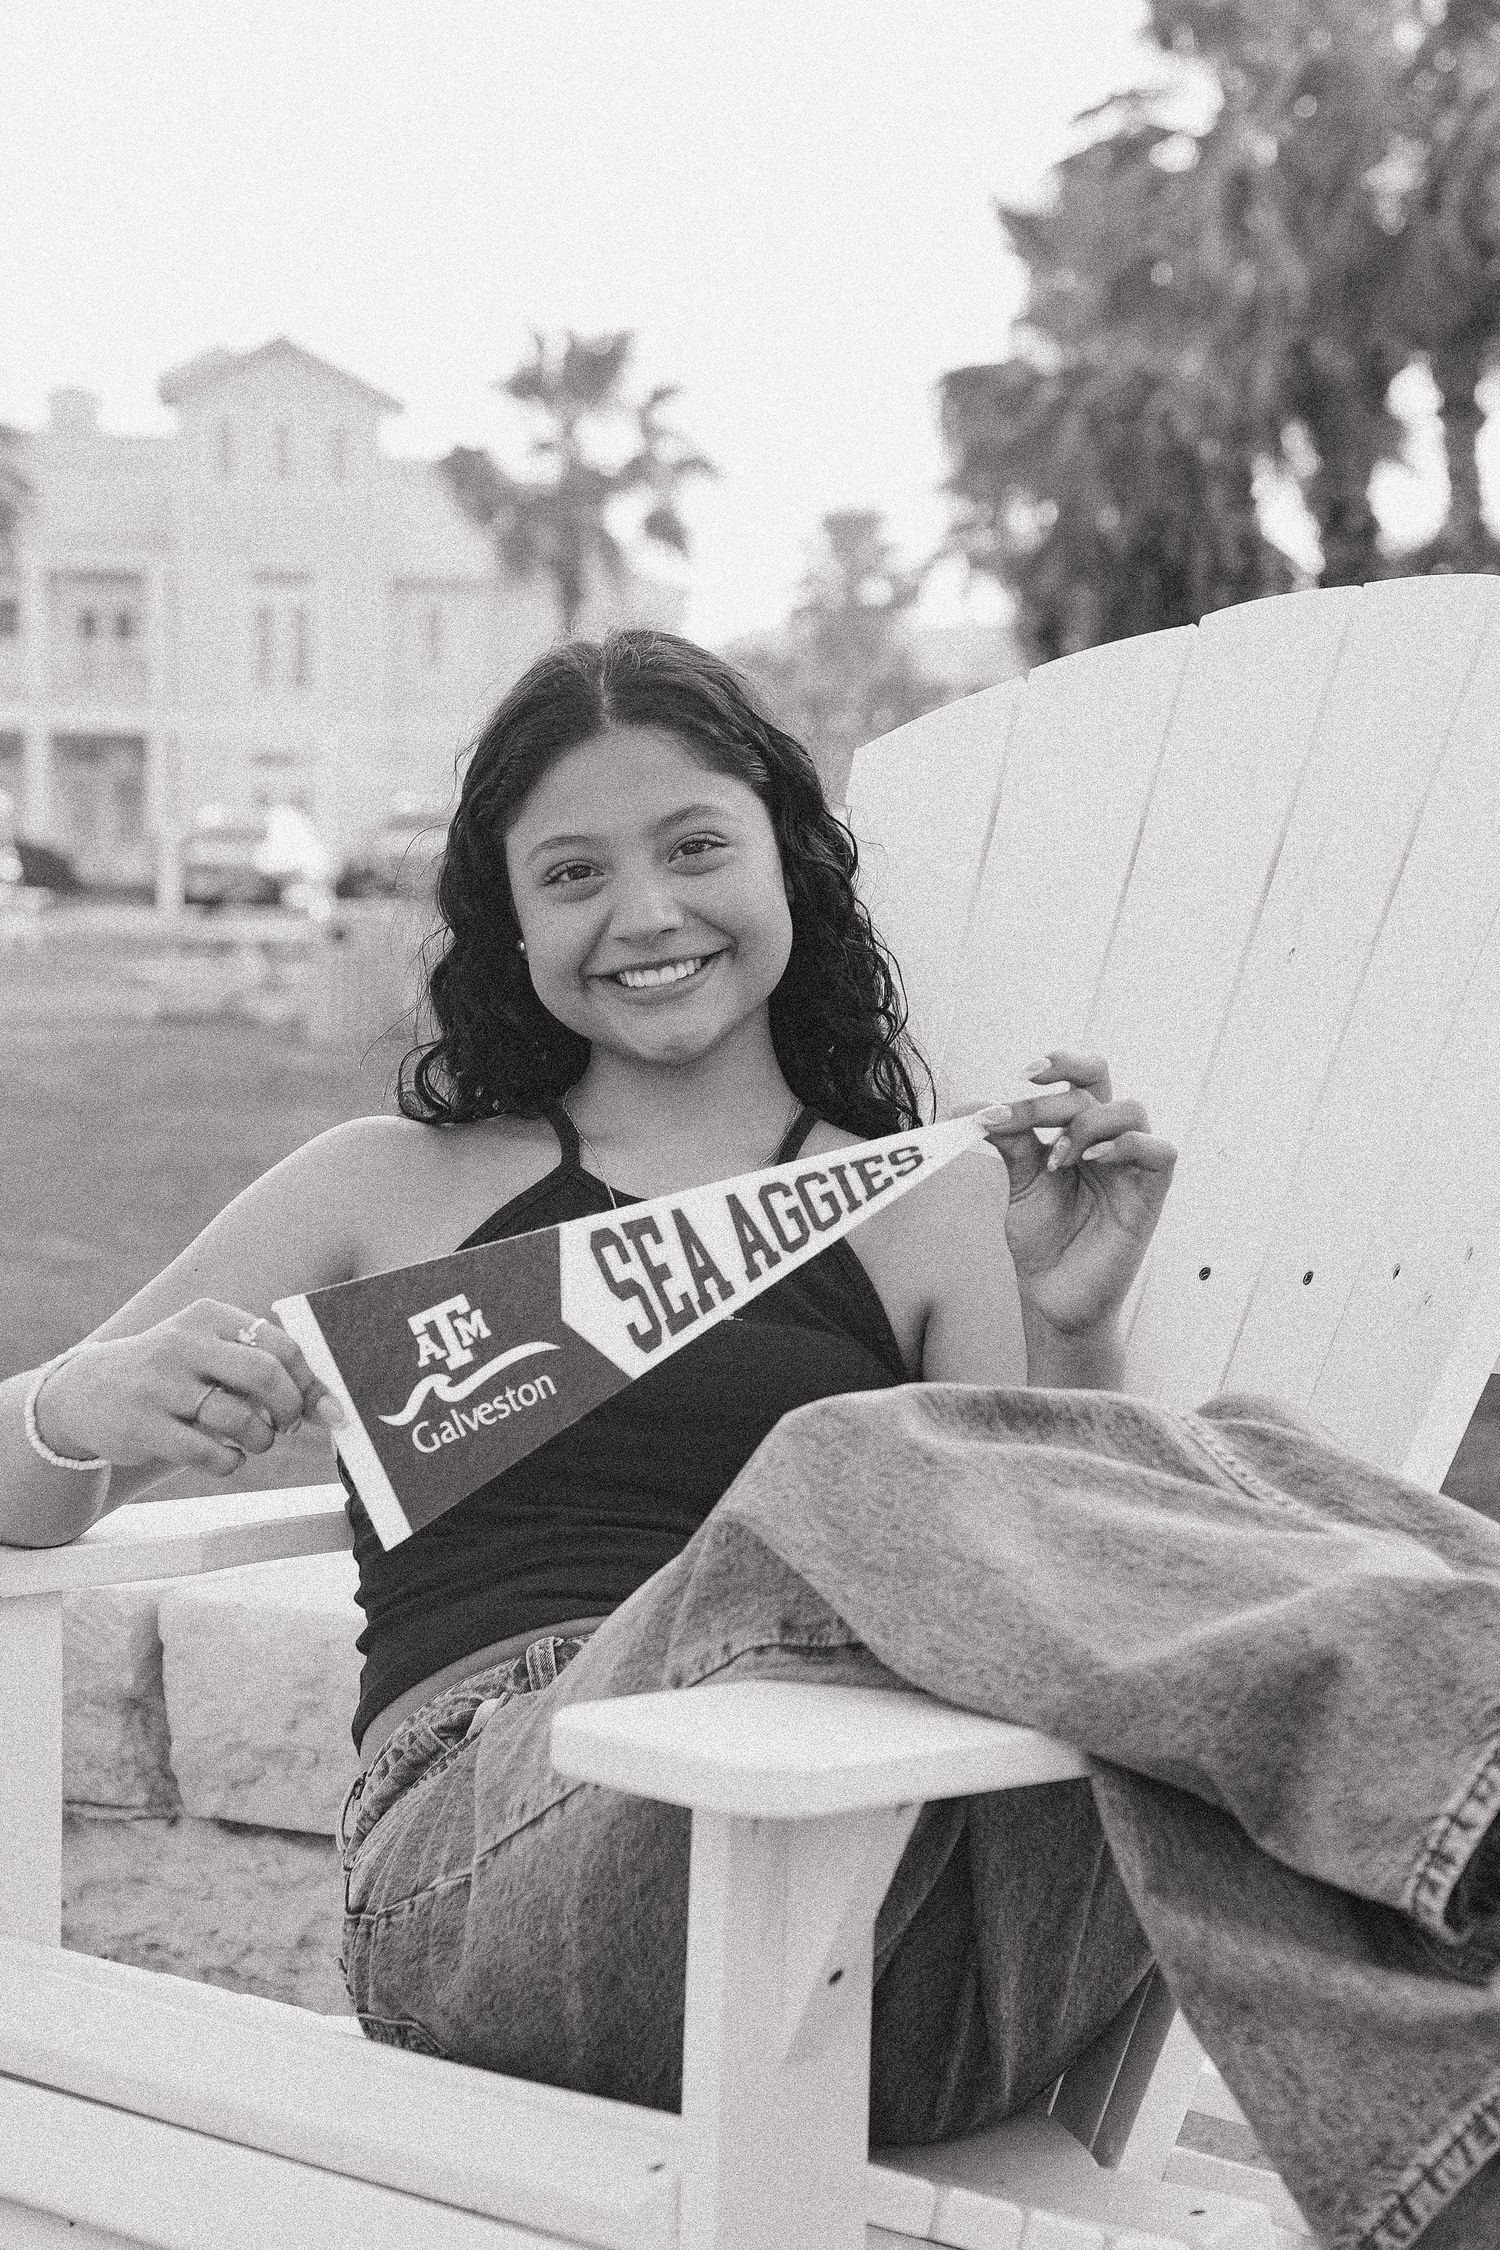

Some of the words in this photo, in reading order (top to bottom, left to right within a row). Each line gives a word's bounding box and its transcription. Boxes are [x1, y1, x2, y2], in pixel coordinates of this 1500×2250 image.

[590, 1208, 736, 1354] SEA
[725, 1146, 924, 1283] AGGIES
[411, 1374, 557, 1453] Galveston
